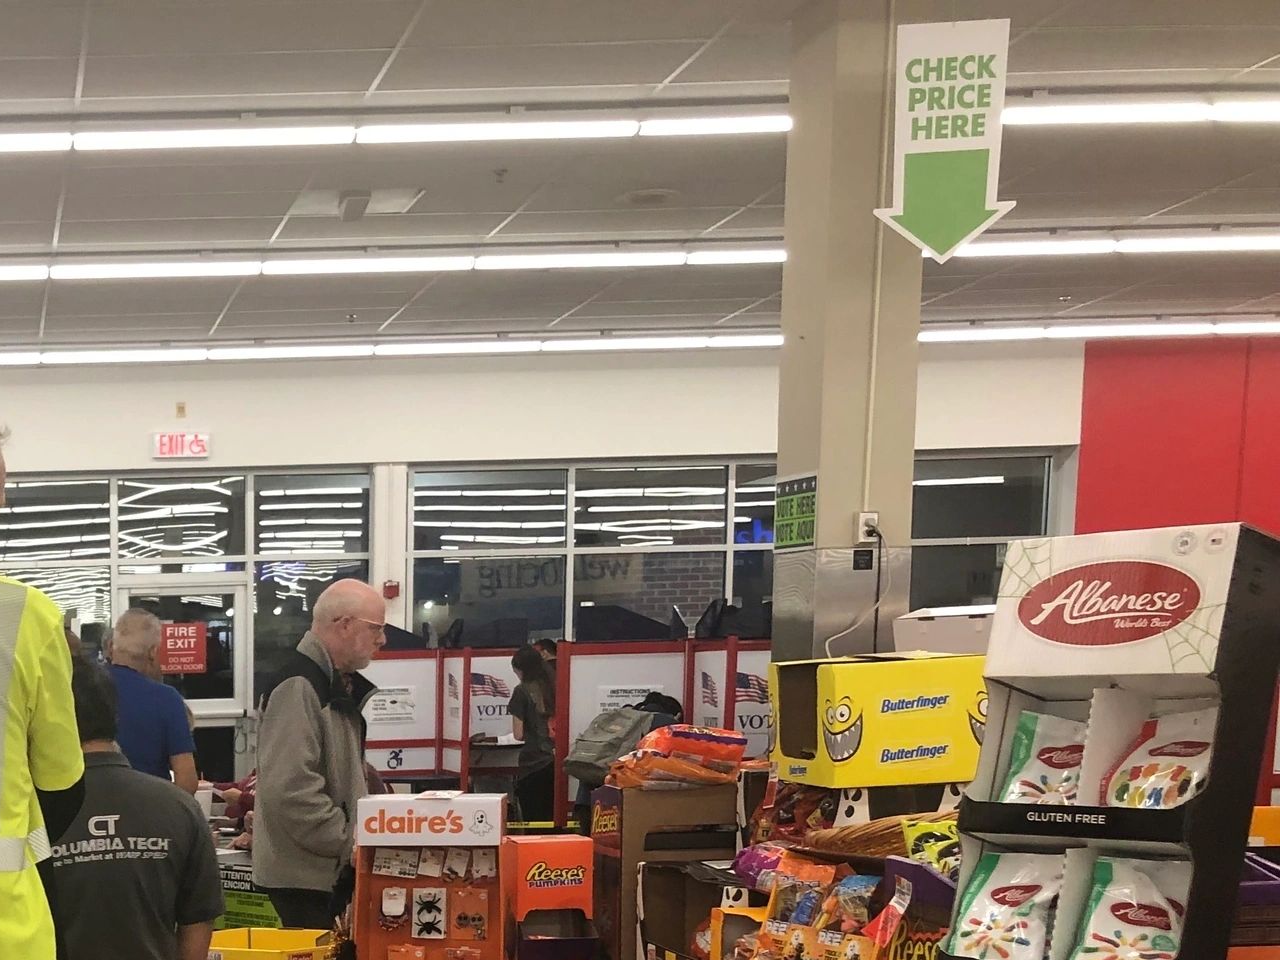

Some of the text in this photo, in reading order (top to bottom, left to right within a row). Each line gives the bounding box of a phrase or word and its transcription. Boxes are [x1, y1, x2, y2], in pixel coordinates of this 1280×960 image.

[905, 54, 997, 83] CHECK
[908, 84, 991, 112] PRICE
[911, 113, 986, 141] HERE
[160, 433, 186, 456] EXIT
[777, 493, 815, 519] VOTE HERE
[777, 521, 794, 545] VOTE
[1030, 579, 1184, 625] Albanese
[166, 626, 197, 637] FIRE
[1150, 617, 1172, 628] Best
[166, 638, 197, 649] EXIT
[880, 695, 949, 714] Butterfinger
[738, 714, 773, 730] VOT
[880, 744, 949, 763] Butterfinger
[88, 815, 120, 836] CT
[364, 809, 464, 834] claire's
[1027, 811, 1106, 825] GLUTEN FREE
[51, 836, 170, 858] OLUMBIA TECH
[75, 854, 103, 863] Market
[220, 871, 251, 881] TTENTIO
[525, 862, 585, 881] Reese's
[220, 881, 250, 890] TENCION
